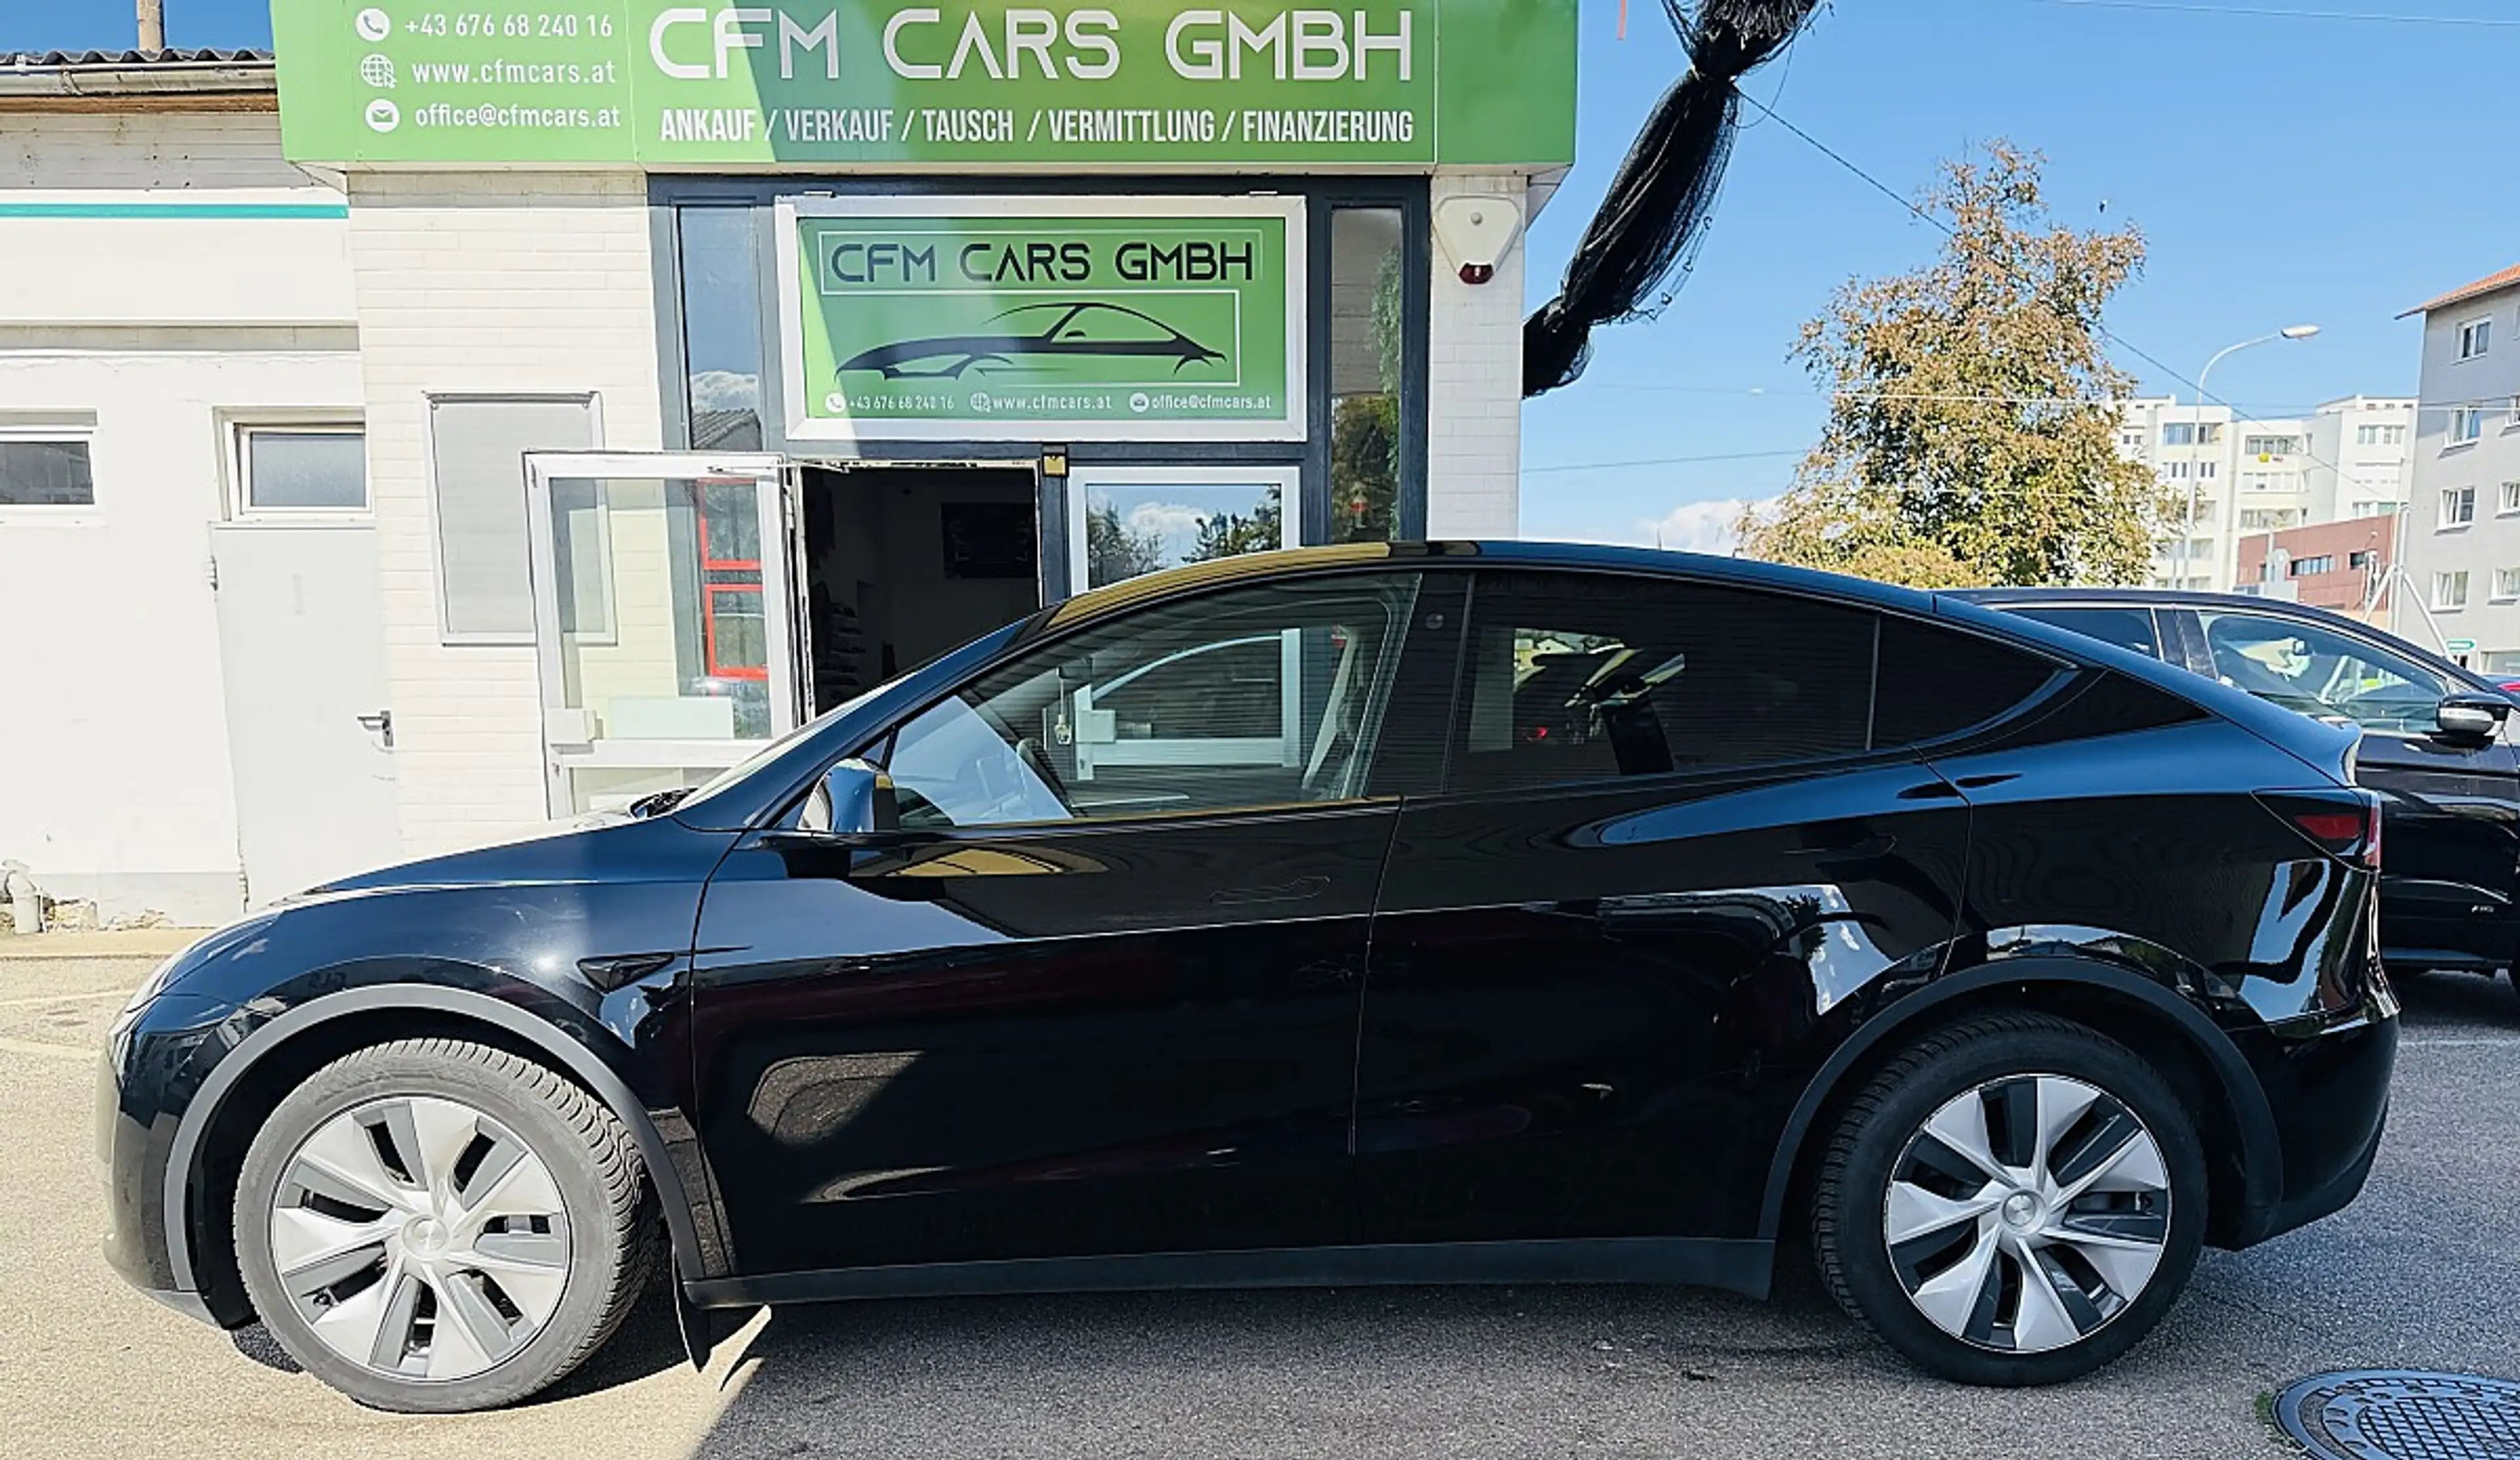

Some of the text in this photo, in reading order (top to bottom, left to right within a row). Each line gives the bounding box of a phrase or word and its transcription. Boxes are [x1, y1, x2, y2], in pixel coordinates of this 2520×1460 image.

[405, 14, 613, 36] +43 676 68 240 16
[648, 8, 1412, 80] CFM CARS GMBH
[412, 58, 616, 83] www.cfmcars.at
[415, 103, 620, 127] office@cfmcars.at
[660, 109, 757, 142] ANKAUF
[784, 109, 894, 142] VERKAUF
[921, 110, 1013, 142] TAUSCH
[1048, 110, 1215, 142] VERMITTLUNG
[1242, 110, 1414, 142] FINANZIERUNG
[831, 242, 1252, 282] CFM CARS GMBH
[873, 395, 895, 410] 676
[994, 395, 1112, 410] www.cfmcars.at
[1152, 394, 1271, 410] office@cfmcars.at
